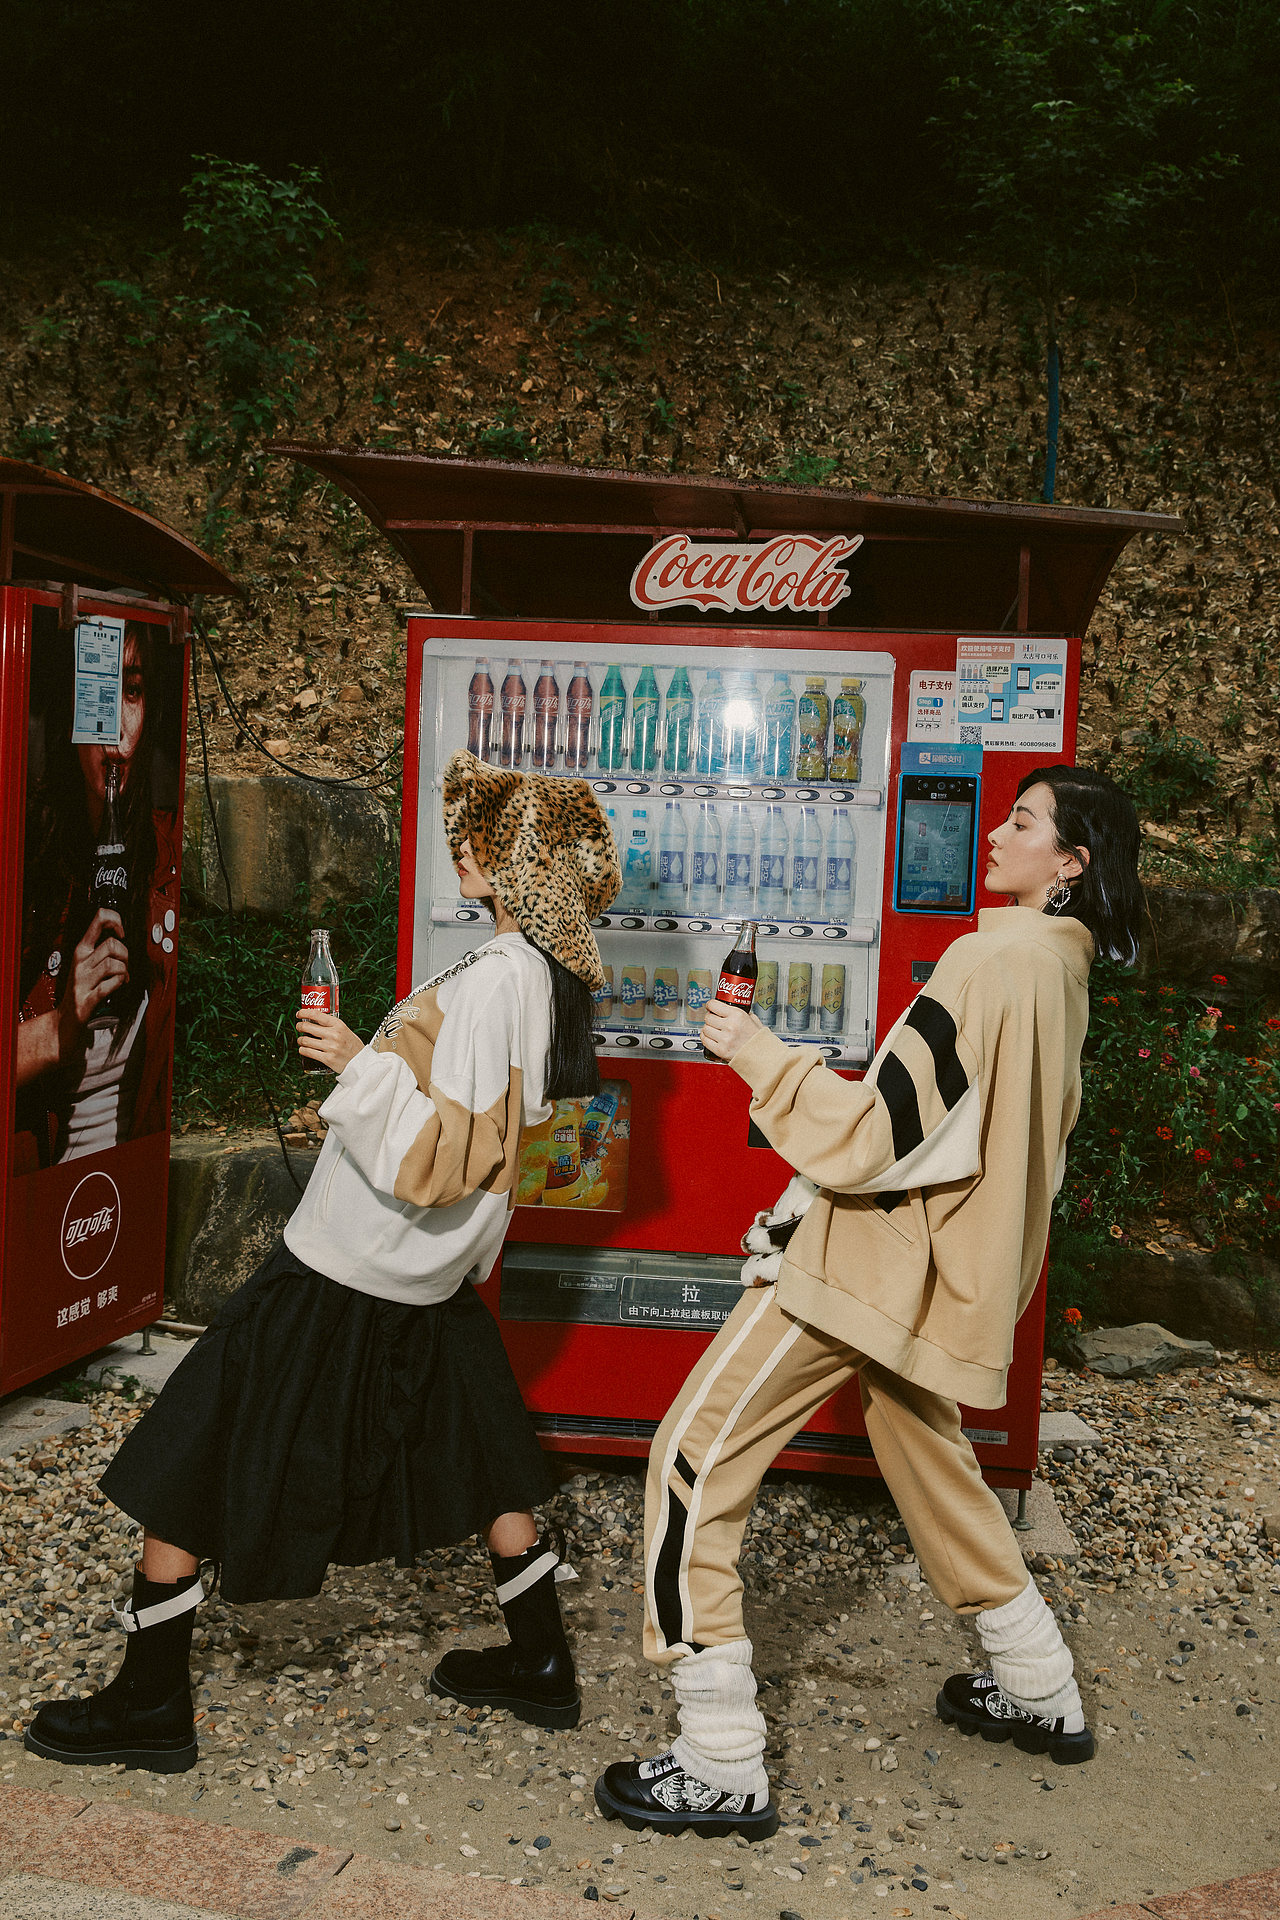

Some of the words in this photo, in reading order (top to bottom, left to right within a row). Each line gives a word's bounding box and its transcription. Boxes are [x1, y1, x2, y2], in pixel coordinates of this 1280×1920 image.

[635, 537, 861, 607] Coca-Cola
[919, 680, 953, 690] 电子支付
[621, 983, 645, 1000] 芬达
[654, 984, 678, 1001] 芬达
[687, 987, 711, 1004] 芬达
[718, 978, 754, 998] Coca-Cola
[65, 1203, 116, 1248] 可口可乐
[682, 1284, 701, 1303] 拉
[56, 1297, 91, 1328] 这感觉
[97, 1285, 118, 1310] 够爽
[628, 1305, 731, 1321] 由下向上拉起盖板取出
